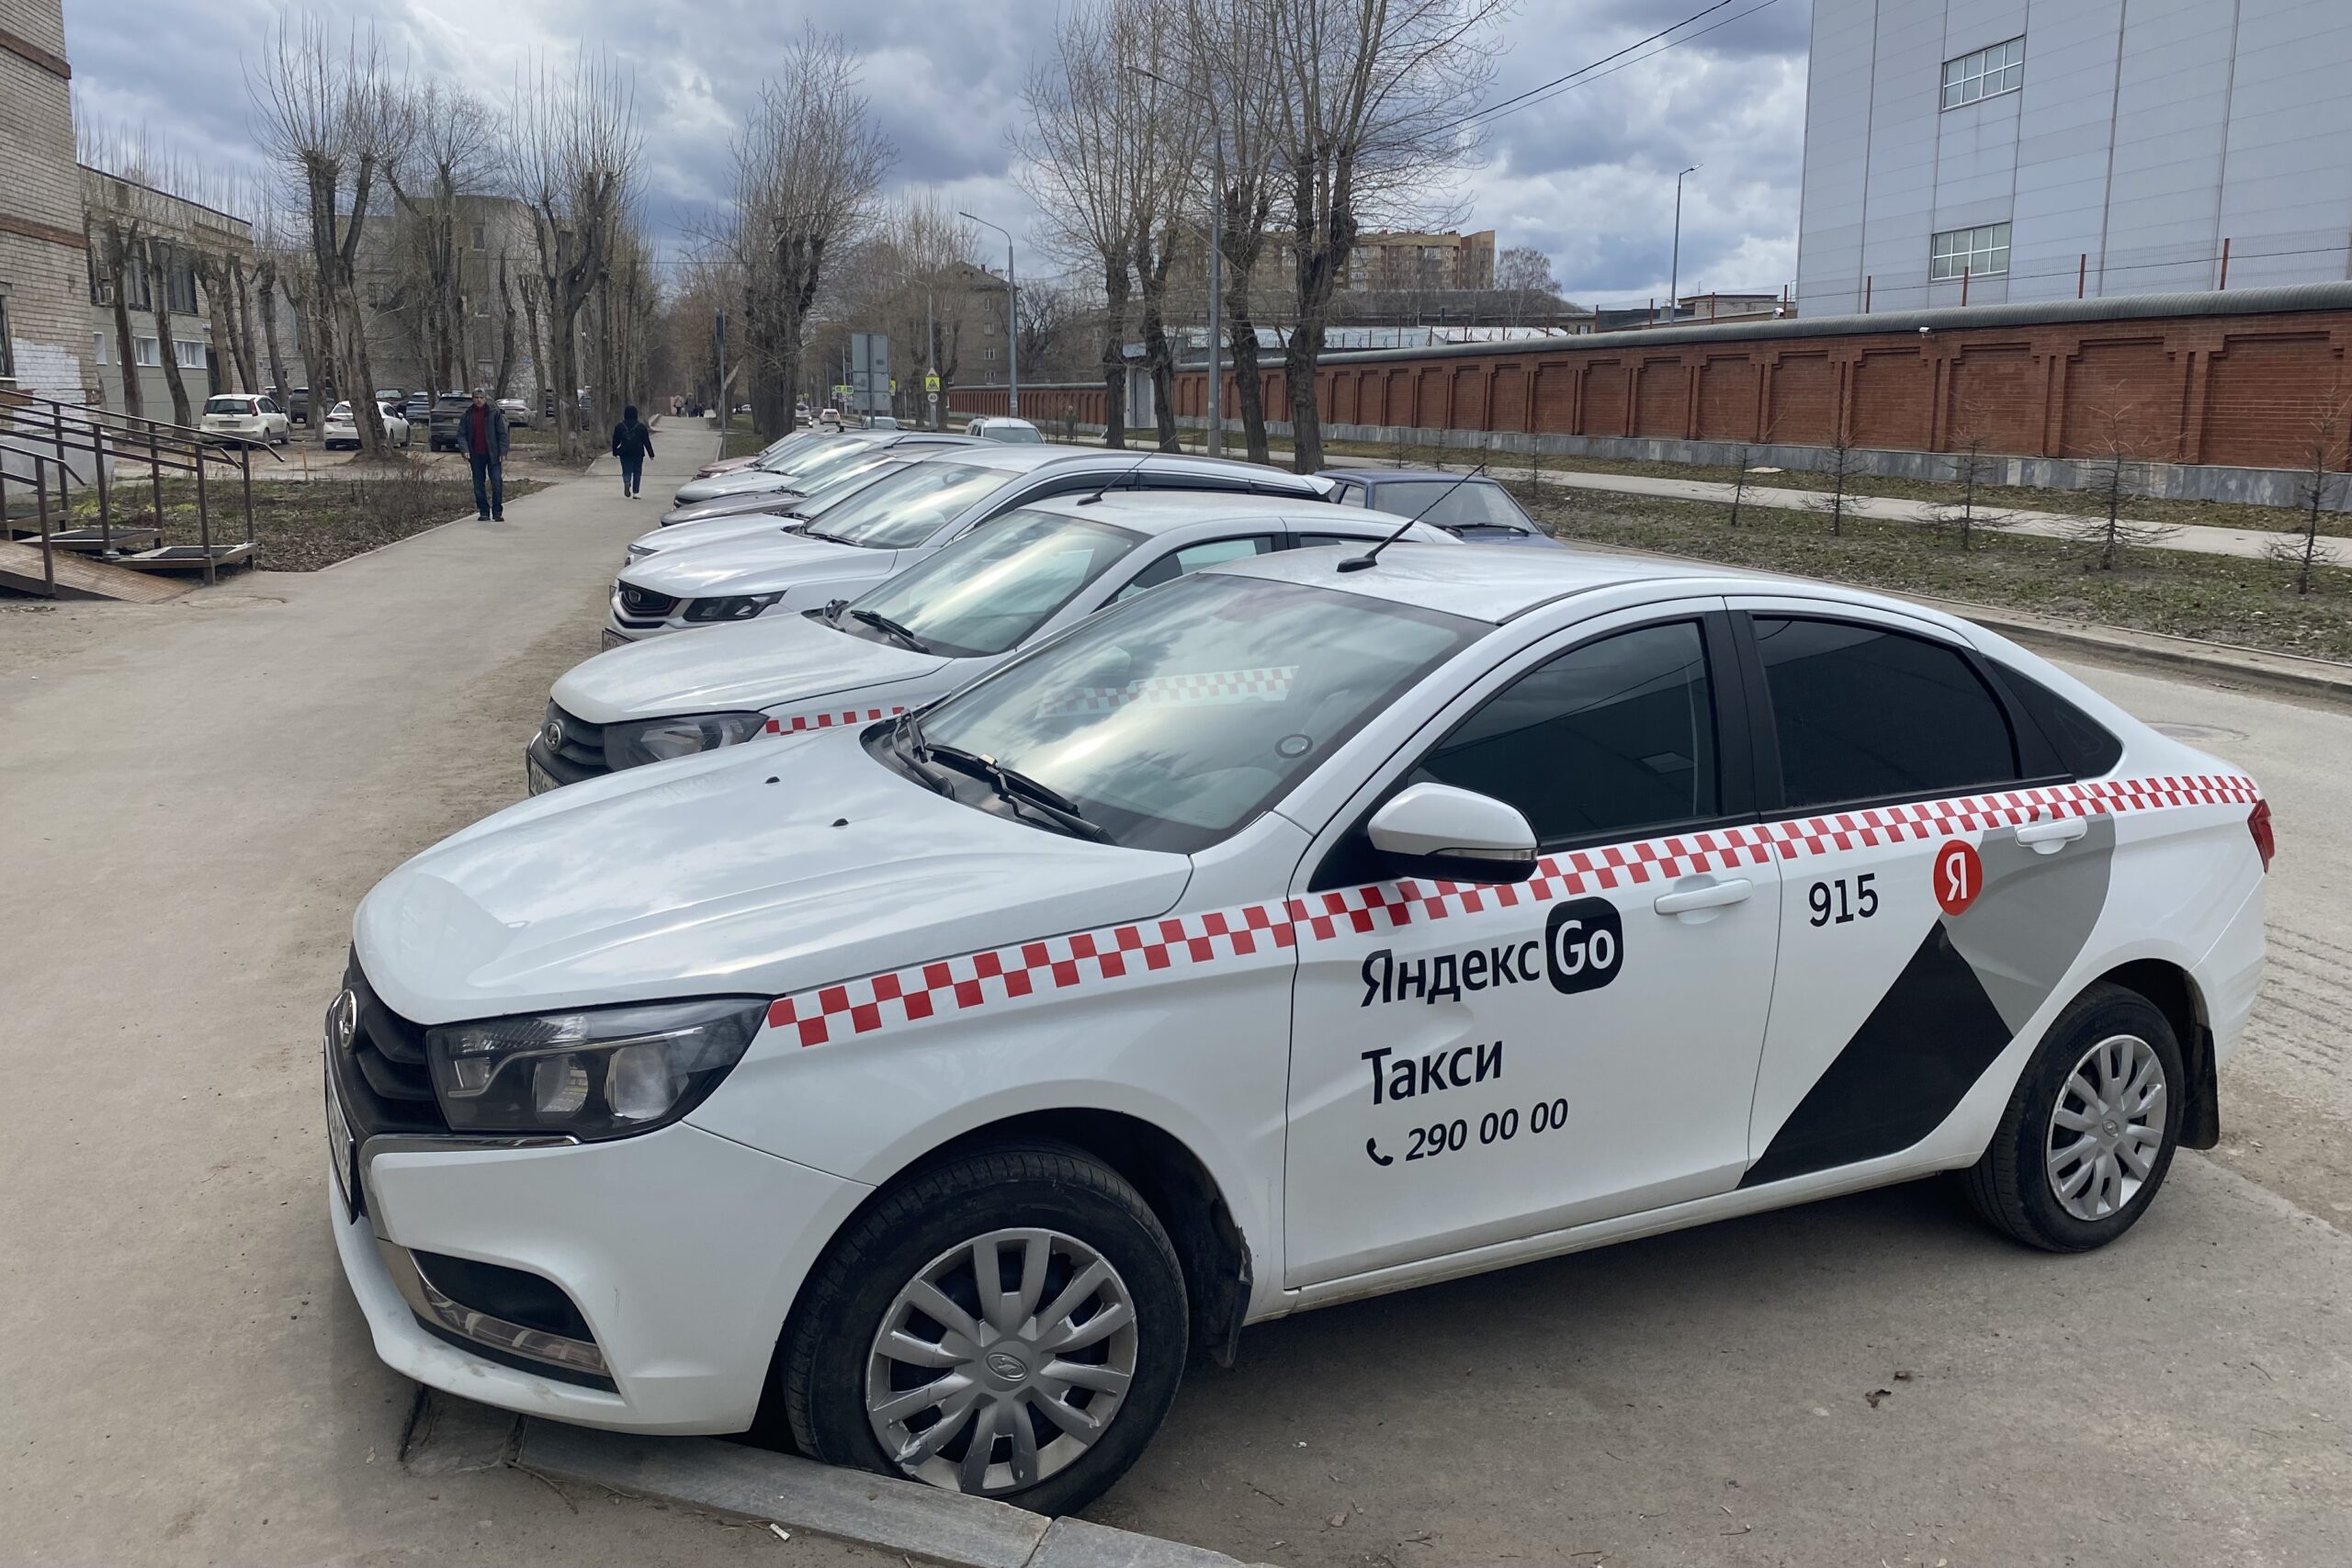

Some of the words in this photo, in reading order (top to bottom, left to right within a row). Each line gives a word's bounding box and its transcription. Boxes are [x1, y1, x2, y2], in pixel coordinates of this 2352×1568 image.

[1809, 873, 1878, 927] 915
[1945, 852, 1968, 901] Я
[1361, 940, 1540, 1007] Яндекс
[1555, 919, 1615, 976] Go
[1362, 1041, 1503, 1105] Такси
[1405, 1119, 1467, 1161] 290
[1479, 1108, 1519, 1145] 00
[1530, 1098, 1568, 1134] 00
